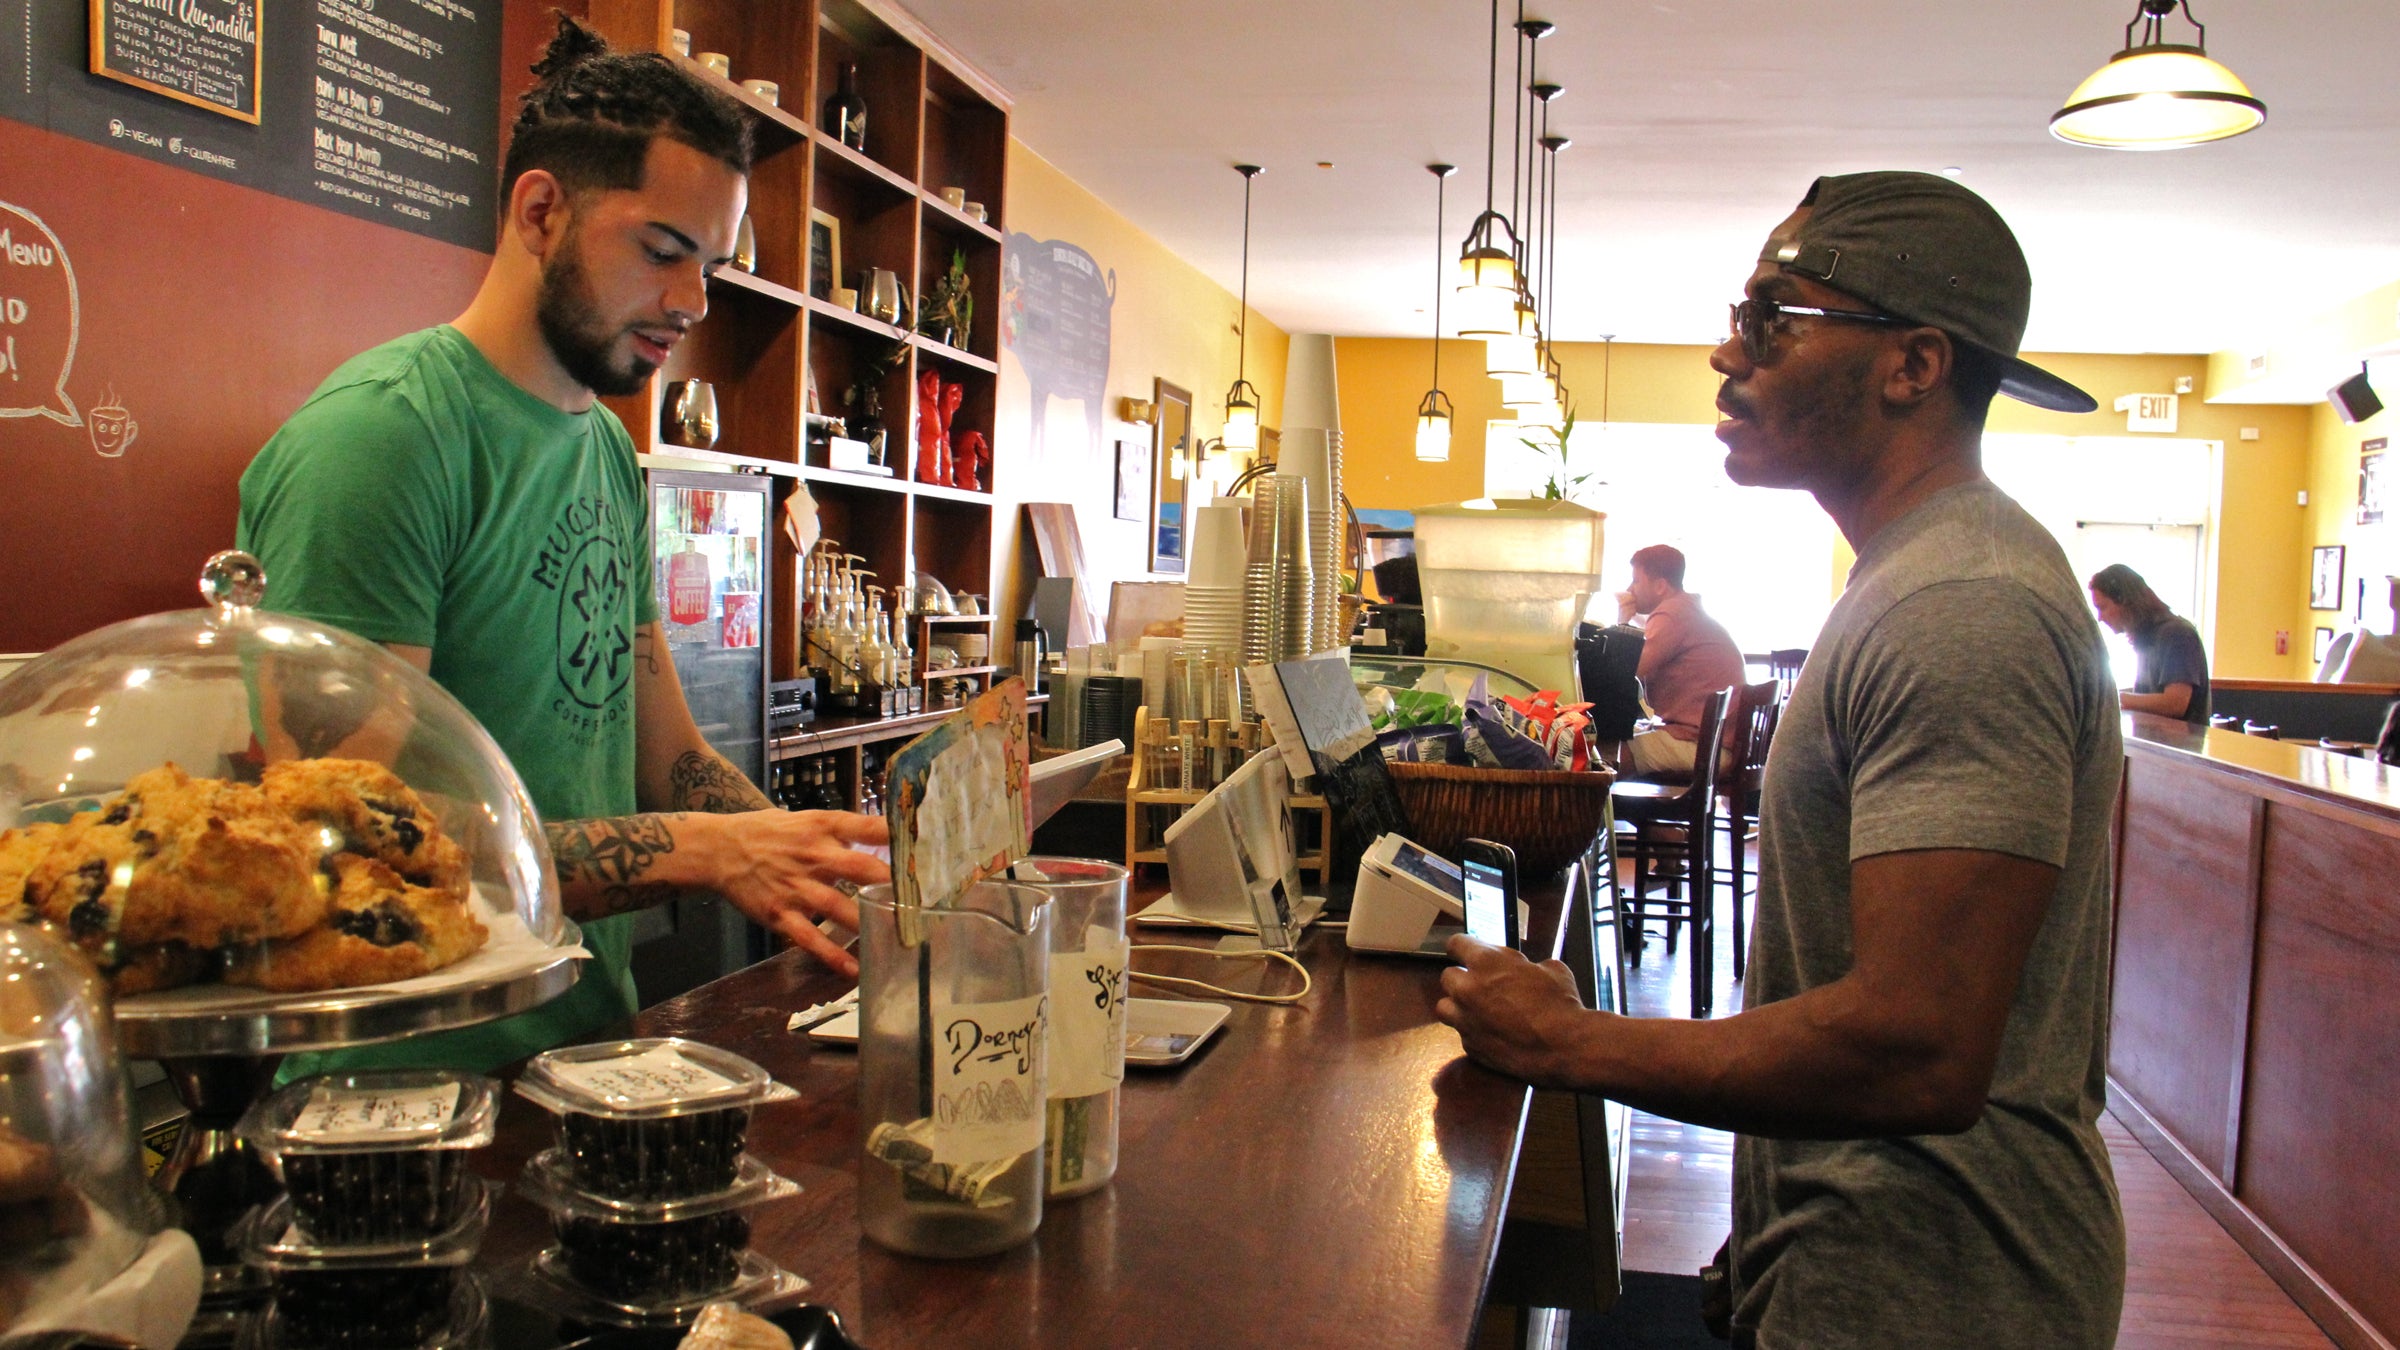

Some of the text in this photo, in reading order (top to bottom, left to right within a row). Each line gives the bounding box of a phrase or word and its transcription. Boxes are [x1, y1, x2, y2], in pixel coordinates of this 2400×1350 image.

[112, 2, 158, 26] ORGANIC
[159, 19, 197, 44] CHICKEN,
[200, 34, 244, 57] AVOCADO,
[179, 0, 256, 44] Quesadilla
[113, 16, 151, 38] PEPPER
[153, 30, 177, 49] JACK
[186, 43, 235, 67] CHEDDAR,
[316, 24, 338, 48] Tuna
[114, 43, 194, 81] BUFFALO SAUCE
[201, 62, 223, 76] AND
[224, 70, 246, 88] OUR
[181, 80, 190, 91] 2
[314, 127, 334, 150] Black
[2140, 396, 2170, 419] EXIT
[674, 588, 706, 616] COFFEE
